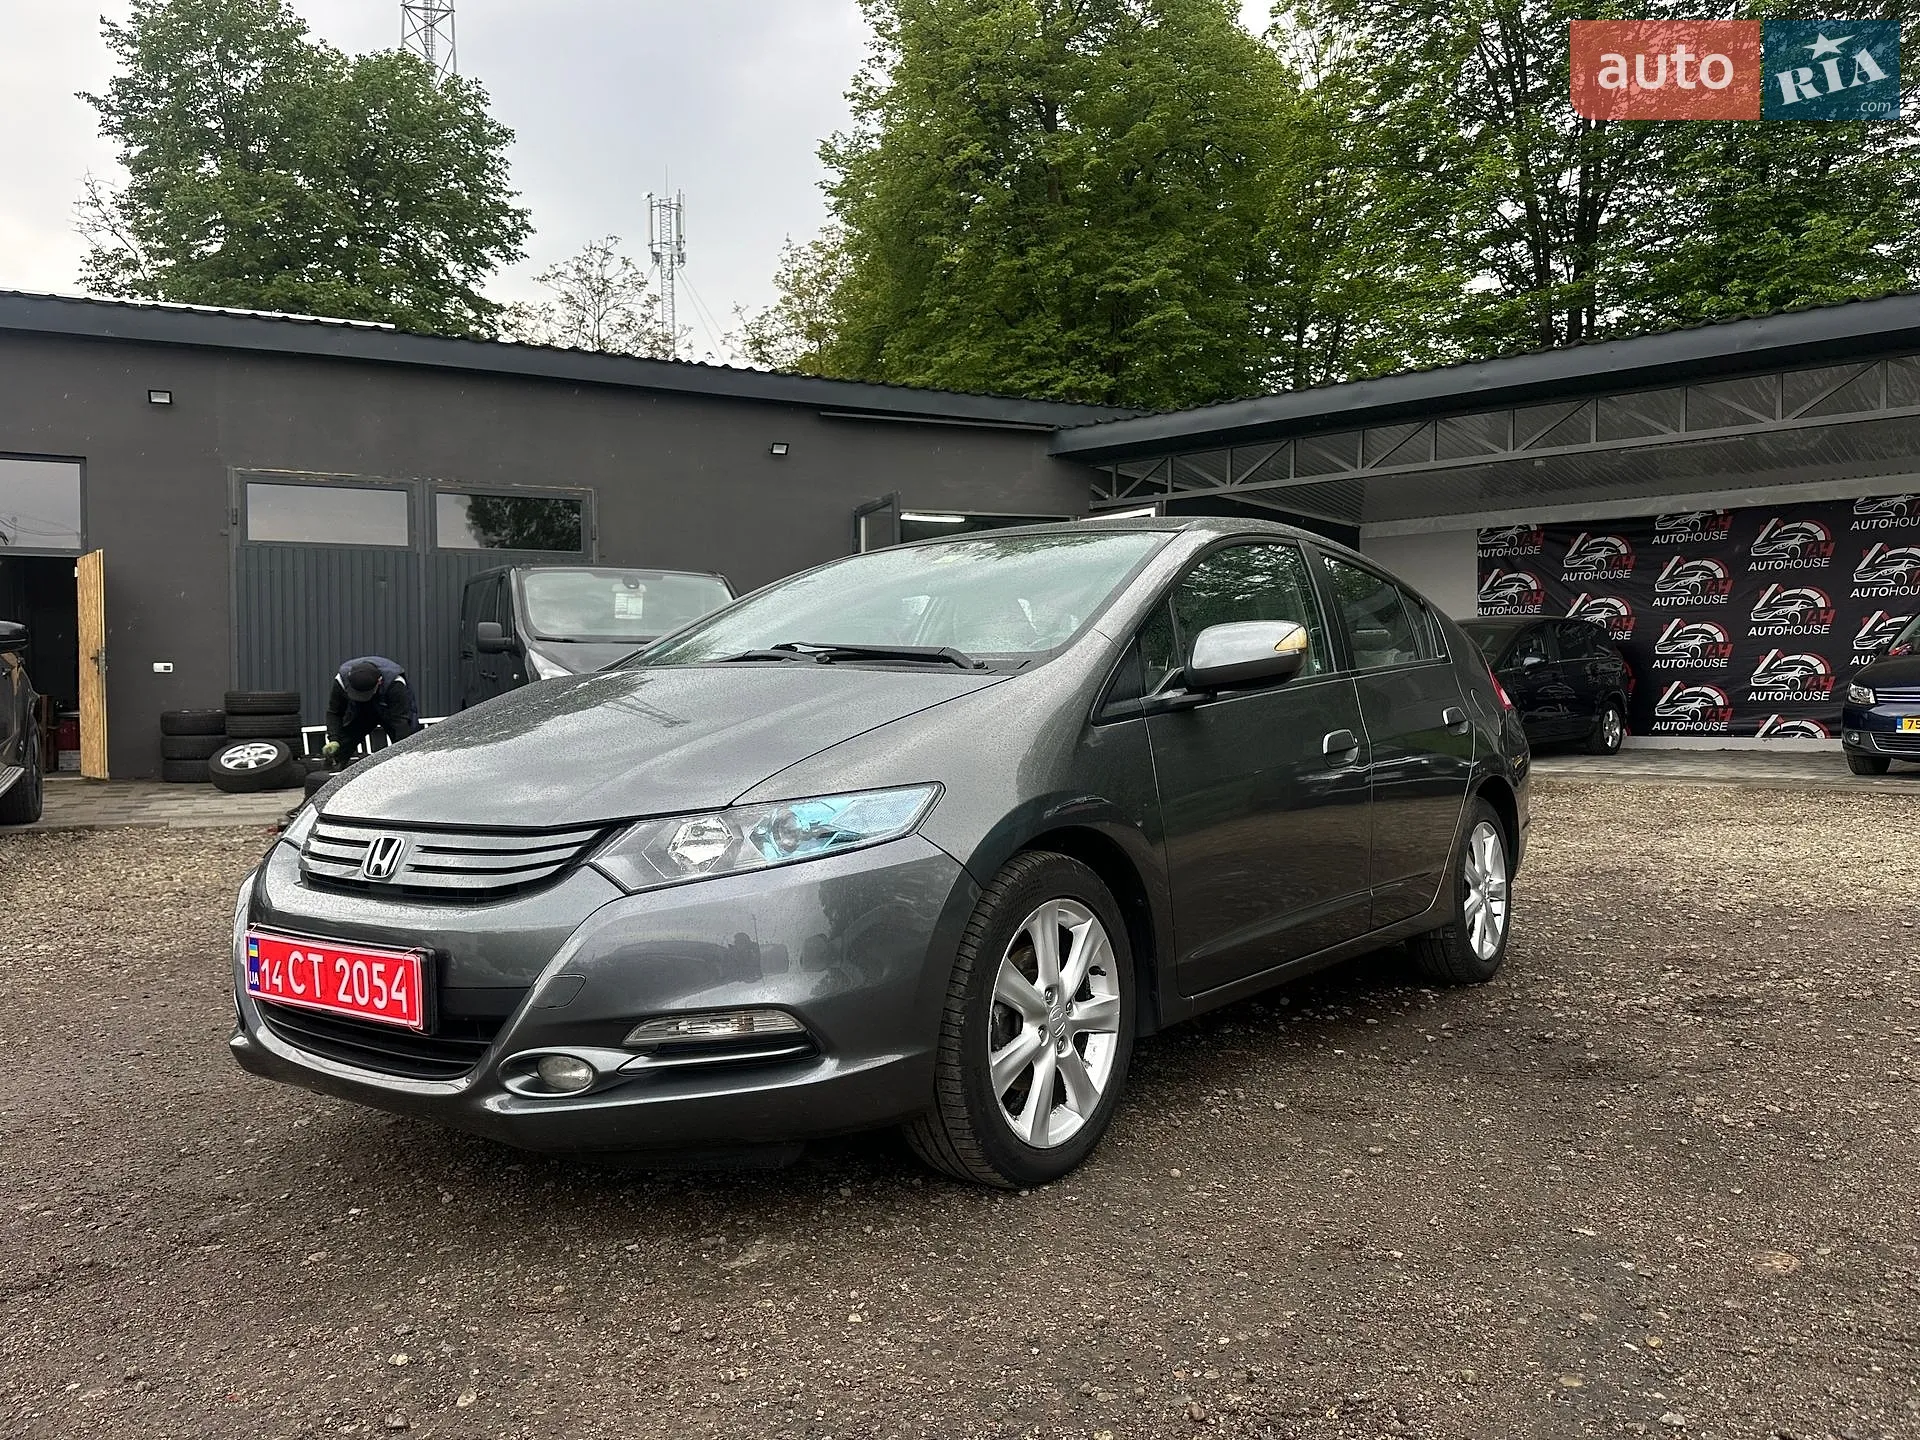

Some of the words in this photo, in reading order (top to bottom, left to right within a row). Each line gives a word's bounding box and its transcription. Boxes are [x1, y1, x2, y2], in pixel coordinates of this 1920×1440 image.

[1652, 531, 1728, 544] AUTOHOUSE
[1477, 546, 1541, 558] AUTOHOUSE
[1748, 558, 1831, 571] AUTOHOUSE
[1561, 569, 1632, 581] AUTOHOUSE
[1652, 594, 1728, 607] AUTOHOUSE
[1478, 605, 1541, 616] AUTOHOUSE
[1748, 624, 1831, 636] AUTOHOUSE
[1652, 658, 1728, 668] AUTOHOUSE
[1748, 691, 1831, 701] AUTOHOUSE
[1652, 721, 1728, 732] AUTOHOUSE
[249, 971, 259, 986] UA
[335, 957, 407, 1014] 2054
